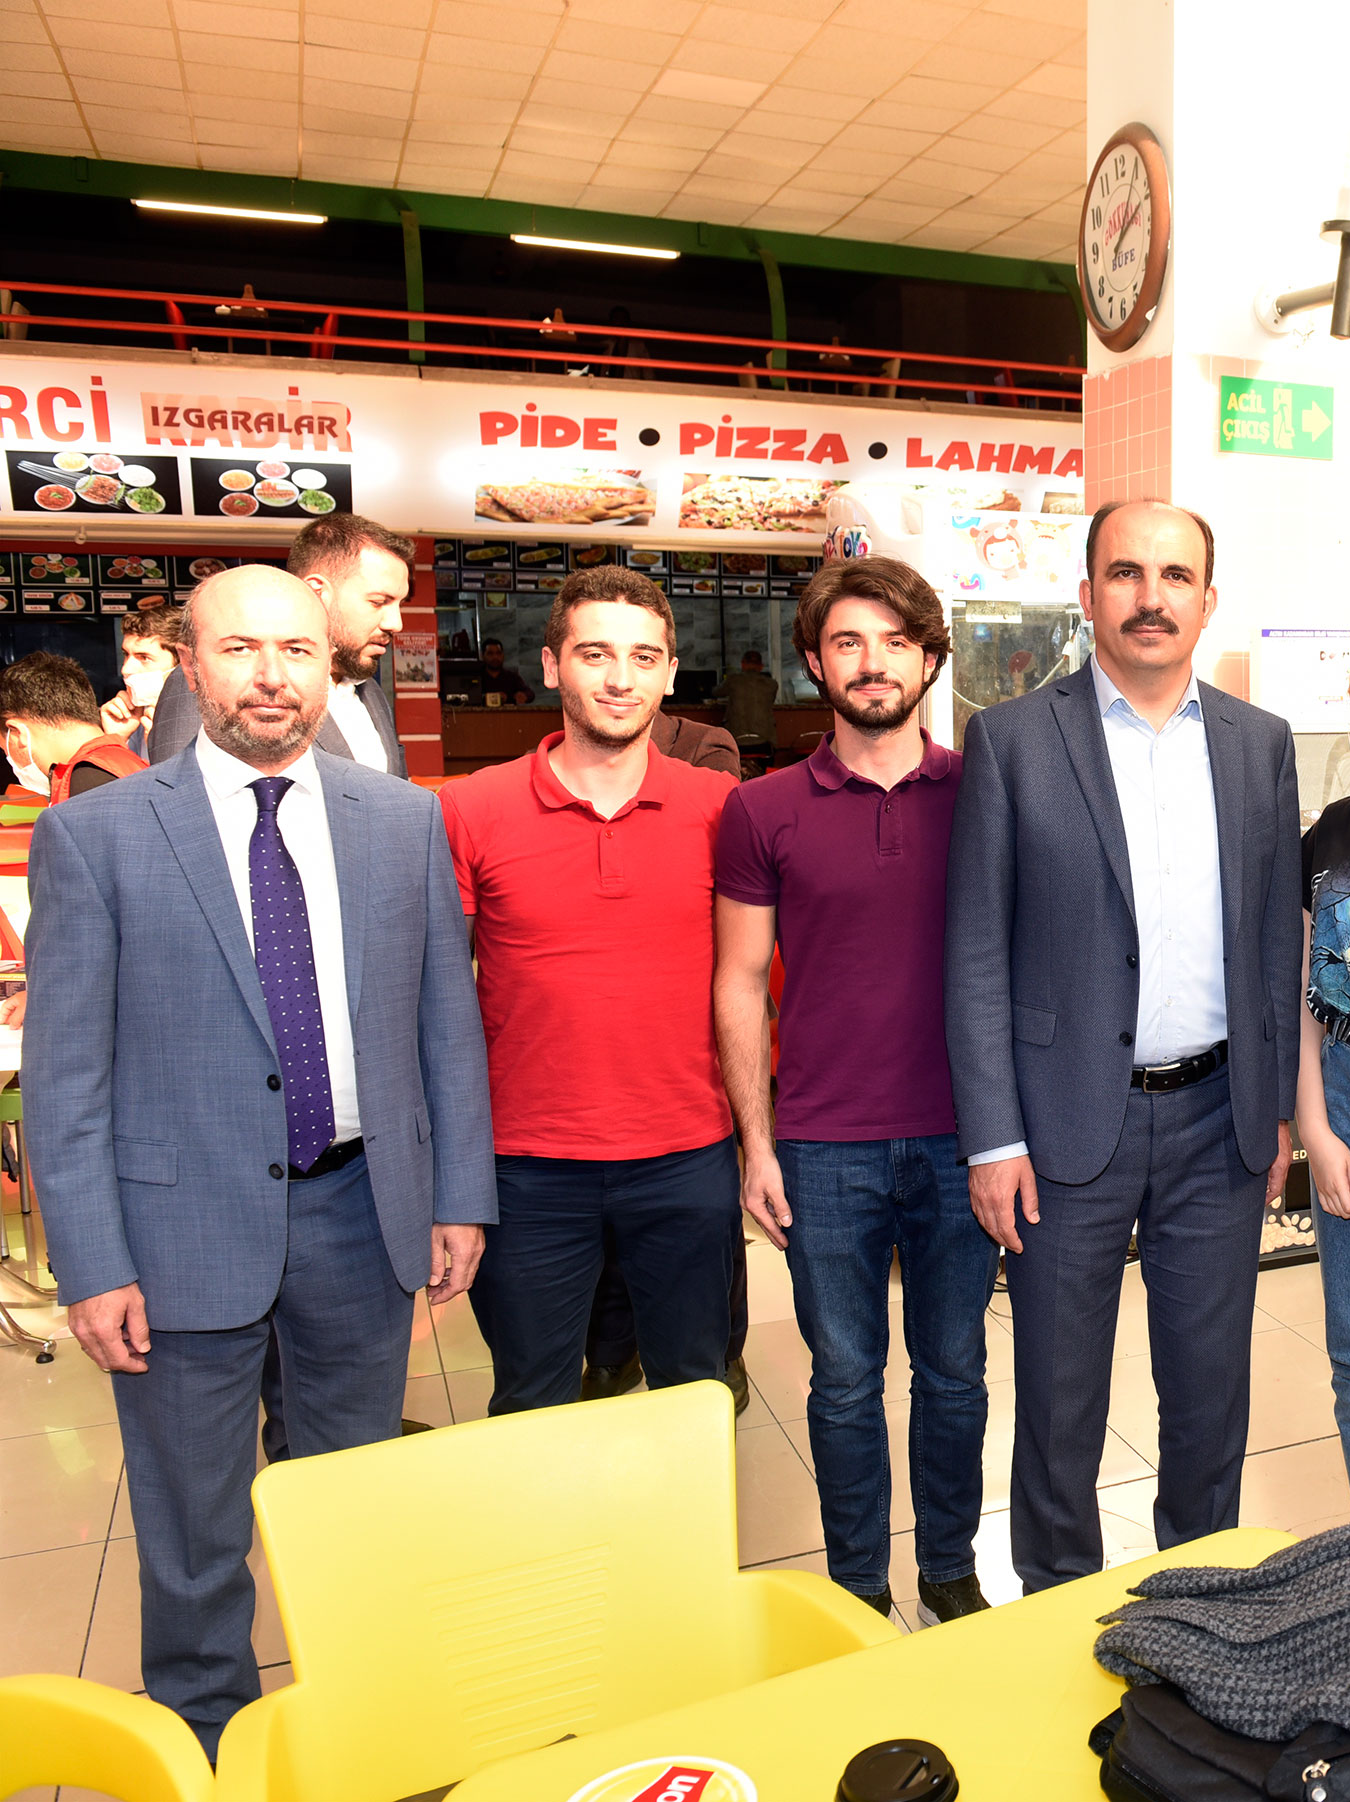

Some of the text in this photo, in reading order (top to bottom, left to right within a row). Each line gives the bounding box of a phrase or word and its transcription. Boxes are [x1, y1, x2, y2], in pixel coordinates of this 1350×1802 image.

[1114, 154, 1126, 181] 12
[1100, 173, 1110, 198] 11
[1091, 205, 1102, 231] 10
[1092, 242, 1099, 264] 9
[1112, 248, 1136, 272] BÜFE
[1098, 275, 1105, 298] 8
[1108, 295, 1114, 320] 7
[1120, 297, 1127, 321] 6
[1227, 388, 1267, 414] ACİL
[151, 406, 338, 438] IZGARALAR
[479, 402, 1084, 478] PİDE PİZZA LAHMA
